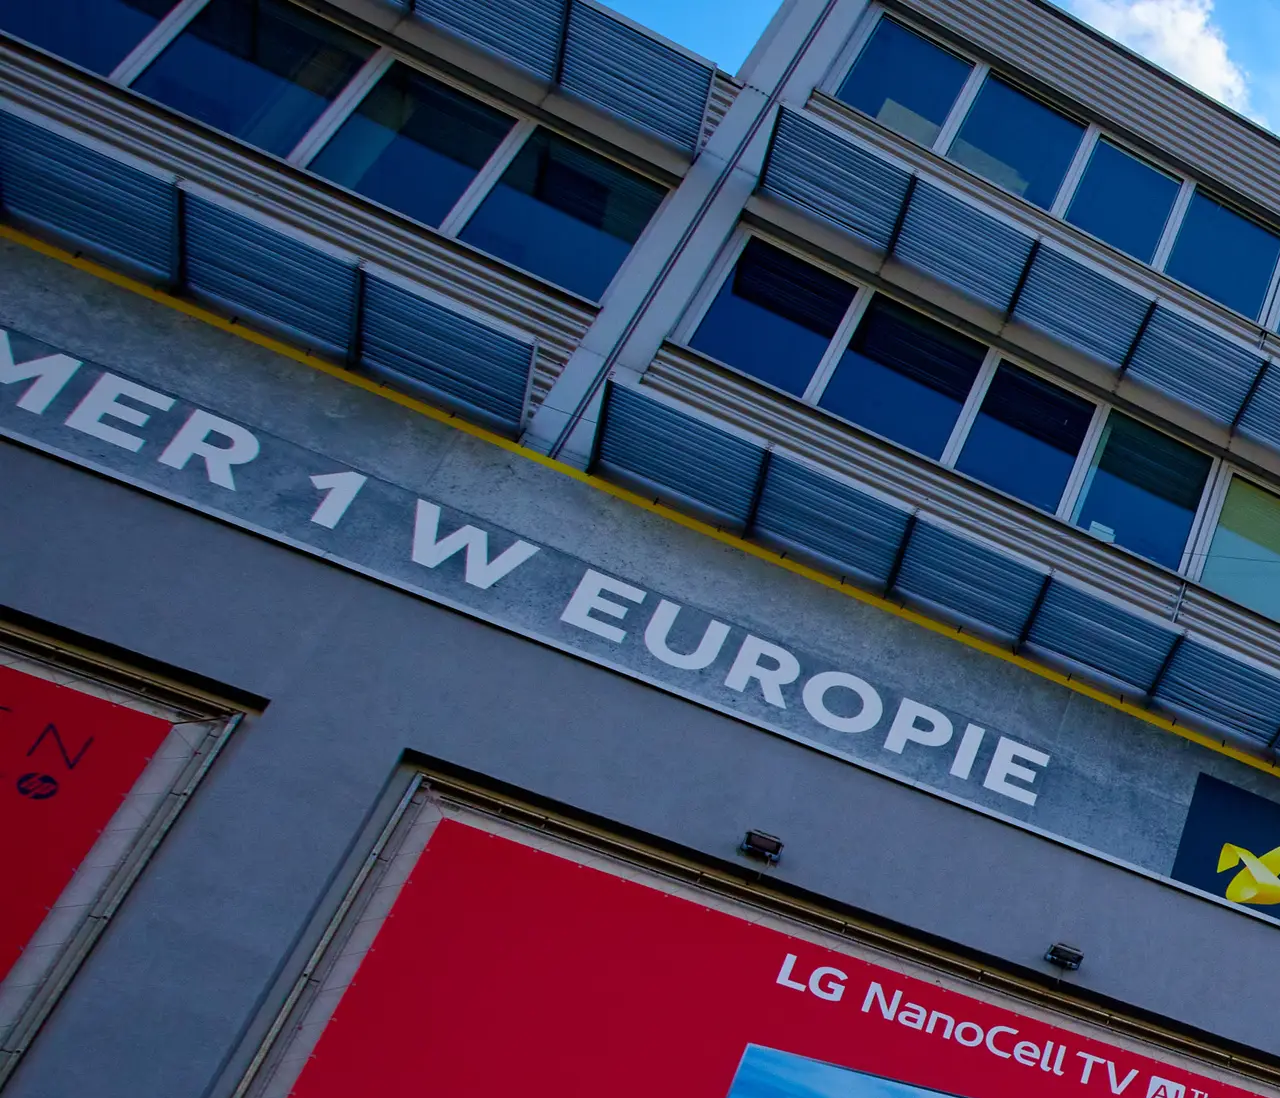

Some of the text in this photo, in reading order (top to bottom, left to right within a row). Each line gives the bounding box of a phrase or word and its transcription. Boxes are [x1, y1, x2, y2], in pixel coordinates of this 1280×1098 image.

[0, 328, 1051, 807] MER 1 W EUROPIE
[775, 952, 848, 1004] LG
[860, 970, 1067, 1077] NanoCell
[1076, 1051, 1140, 1096] TV
